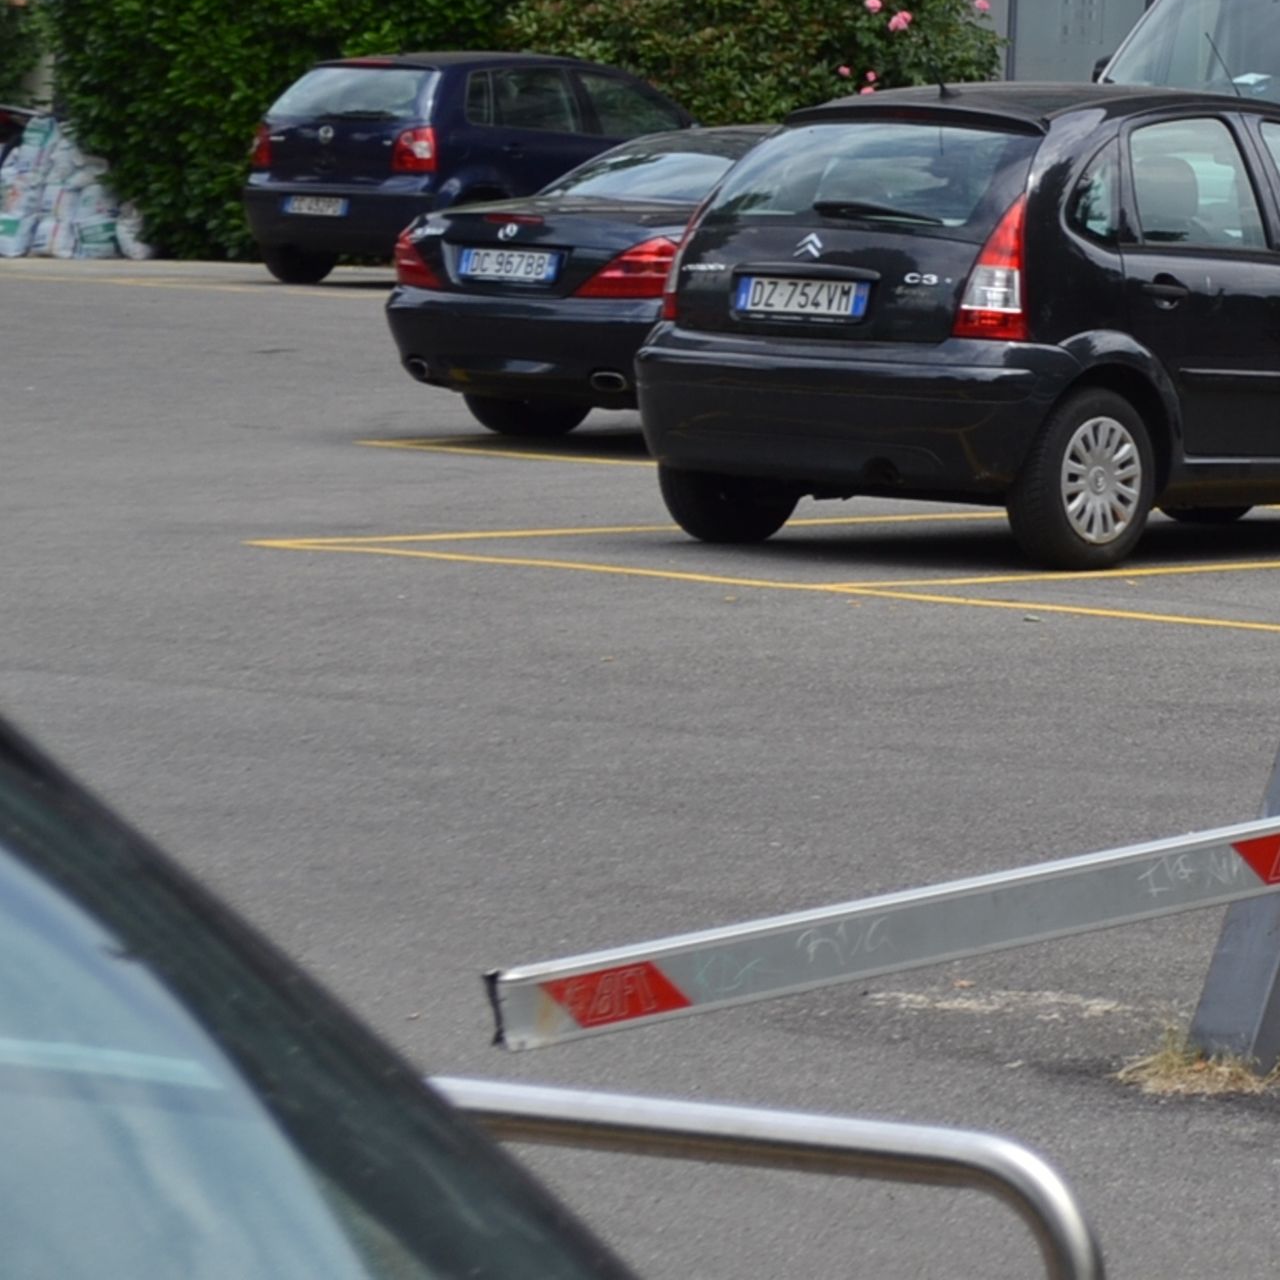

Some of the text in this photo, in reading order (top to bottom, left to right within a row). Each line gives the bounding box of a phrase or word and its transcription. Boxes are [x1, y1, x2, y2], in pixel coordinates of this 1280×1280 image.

[469, 251, 491, 273] DC
[904, 272, 938, 285] C3
[750, 282, 853, 313] DZ 754VM
[587, 965, 656, 1021] BFT
